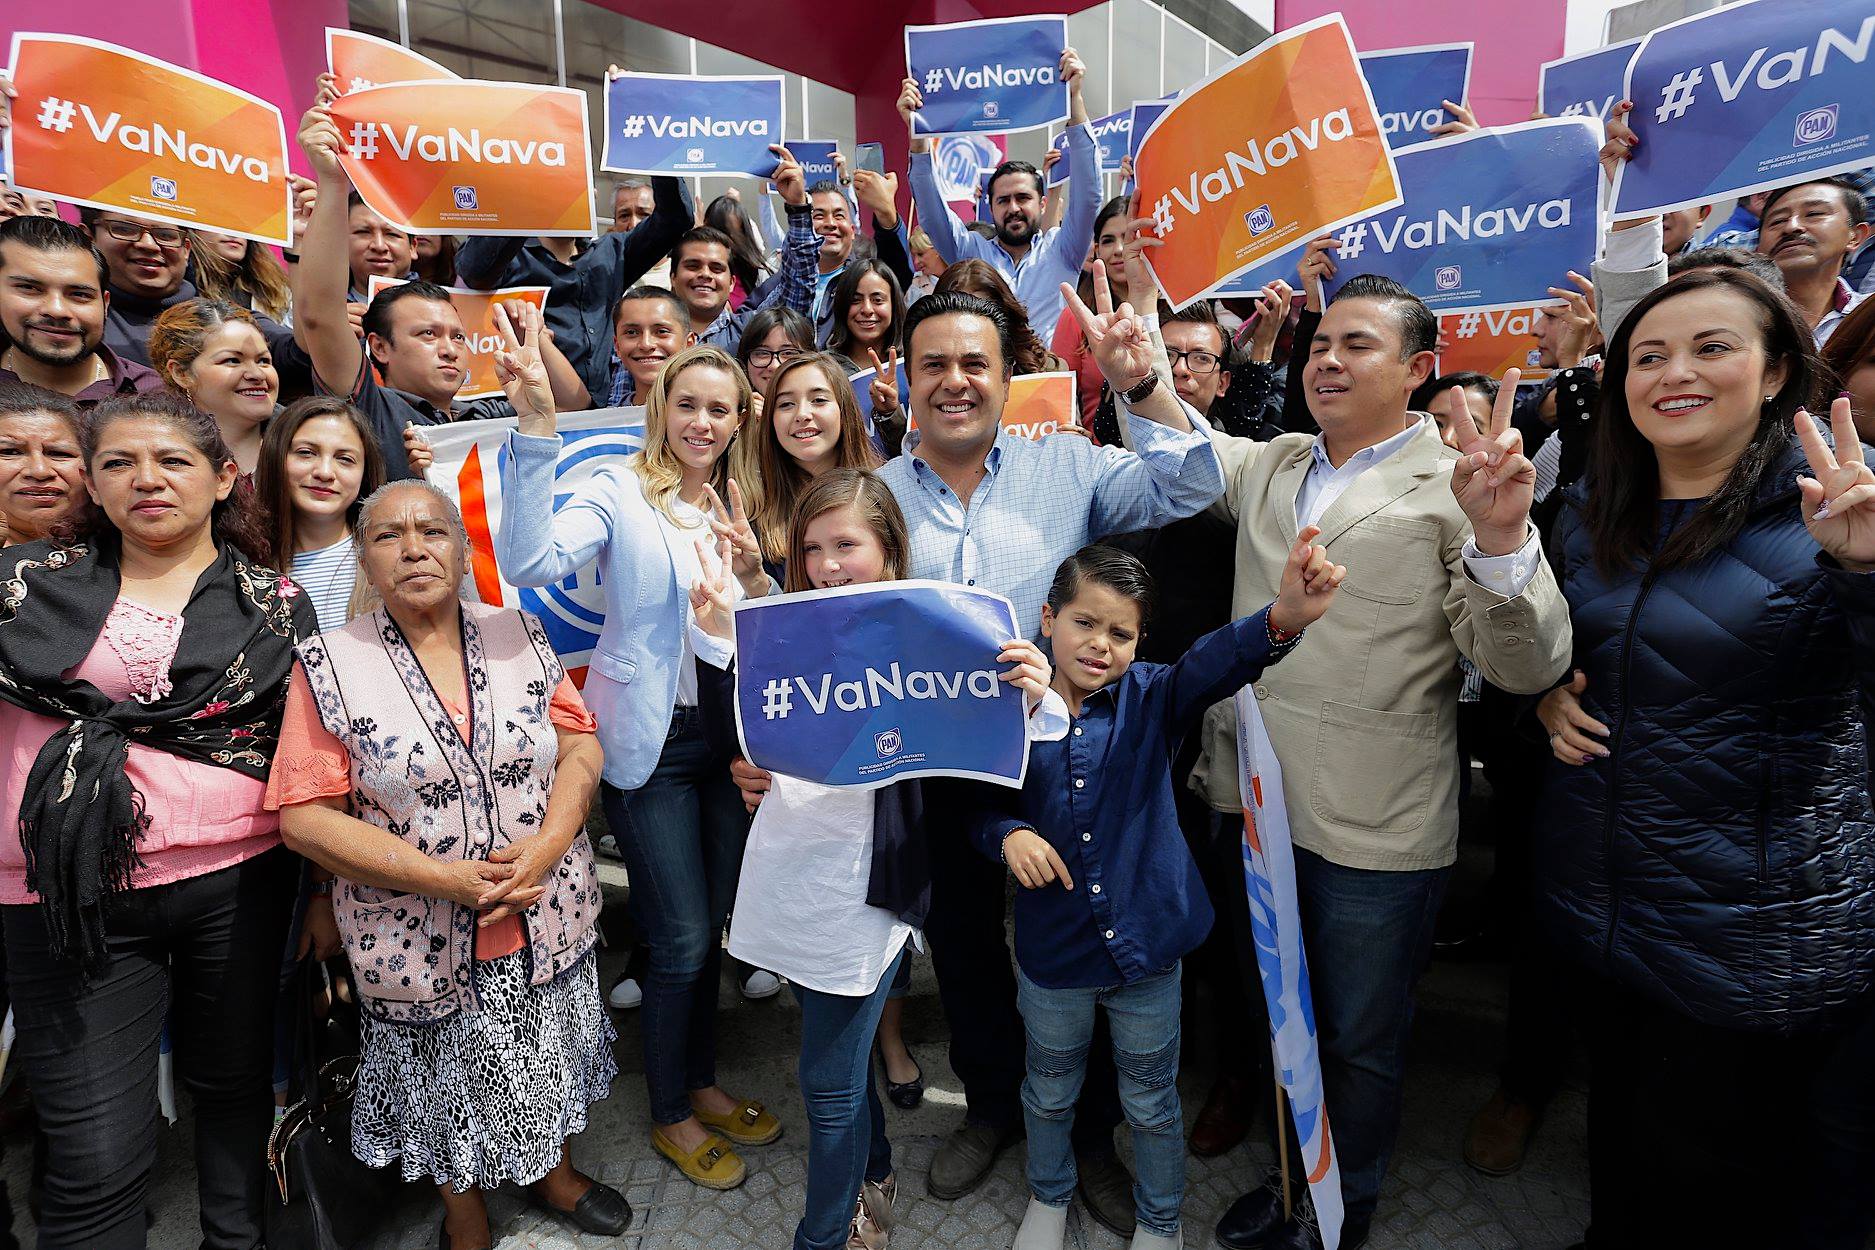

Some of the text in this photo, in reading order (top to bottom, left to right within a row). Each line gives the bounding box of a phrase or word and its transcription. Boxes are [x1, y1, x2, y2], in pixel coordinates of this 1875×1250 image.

[924, 63, 1054, 93] #VaNava
[622, 115, 768, 138] #VaNava
[1803, 115, 1829, 136] PAN
[36, 96, 269, 183] #VaNava
[348, 122, 565, 166] #VaNava
[1152, 107, 1354, 238] #VaNava
[458, 192, 473, 203] PAN
[1252, 212, 1268, 228] PAN
[1337, 198, 1571, 260] #VaNava
[1441, 272, 1456, 283] PAN
[761, 661, 1001, 720] #VaNava
[881, 736, 897, 750] PAN
